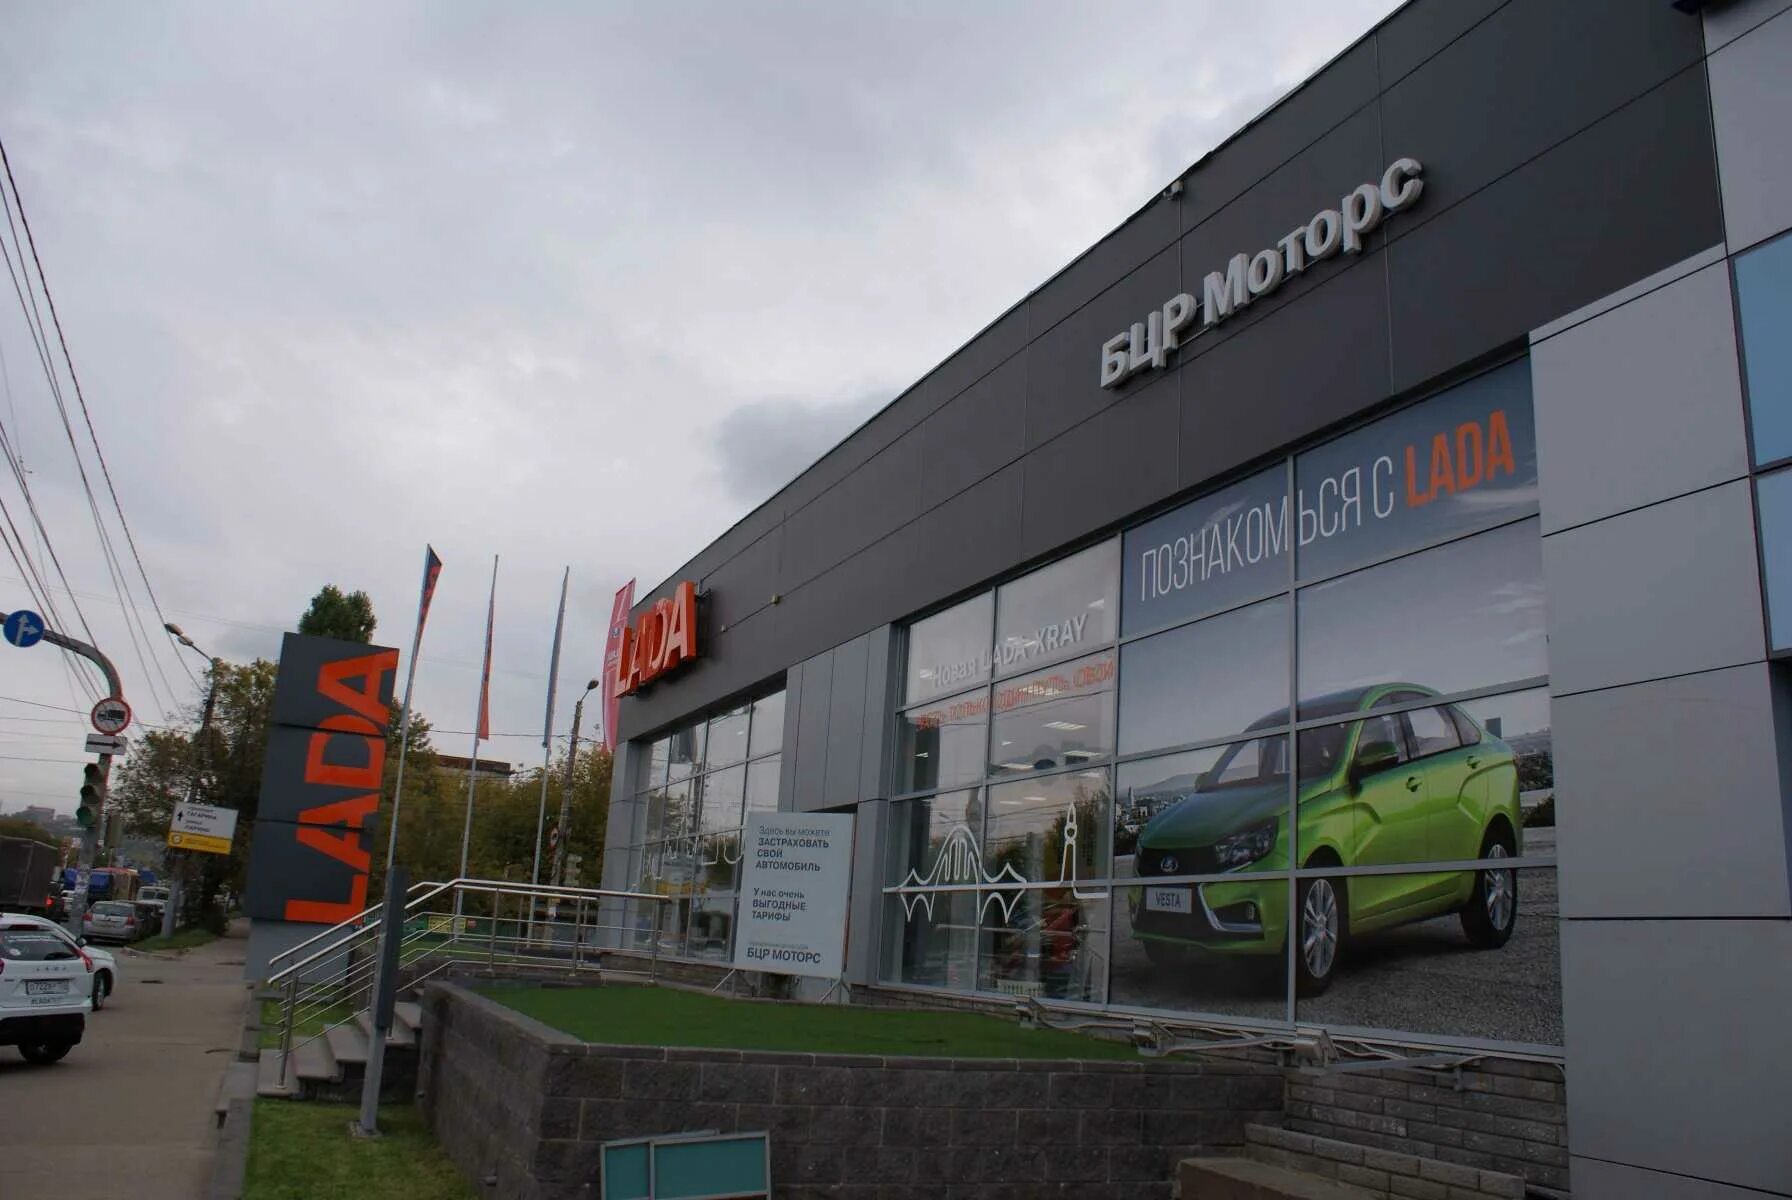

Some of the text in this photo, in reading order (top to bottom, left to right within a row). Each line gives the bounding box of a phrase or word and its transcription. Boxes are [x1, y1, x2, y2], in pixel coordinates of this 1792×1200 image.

[1100, 157, 1425, 390] БЦР Моторс
[1140, 408, 1516, 602] ПОЗНАКОМЬСЯ С LADA
[614, 580, 698, 699] LADA
[932, 612, 1089, 689] Новая LADA XRAY
[284, 649, 400, 925] LADA
[758, 837, 830, 849] ЗАСТРАХОВАТЬ
[757, 847, 783, 858] СВОЙ
[755, 860, 821, 872] АВТОМОБИЛЬ
[753, 887, 805, 899] У нас очень
[1154, 892, 1181, 906] VESTA
[752, 898, 807, 911] ВЫГОДНЫЕ
[751, 910, 791, 921] ТАРИФЫ
[747, 947, 822, 964] БЦР МОТОРС
